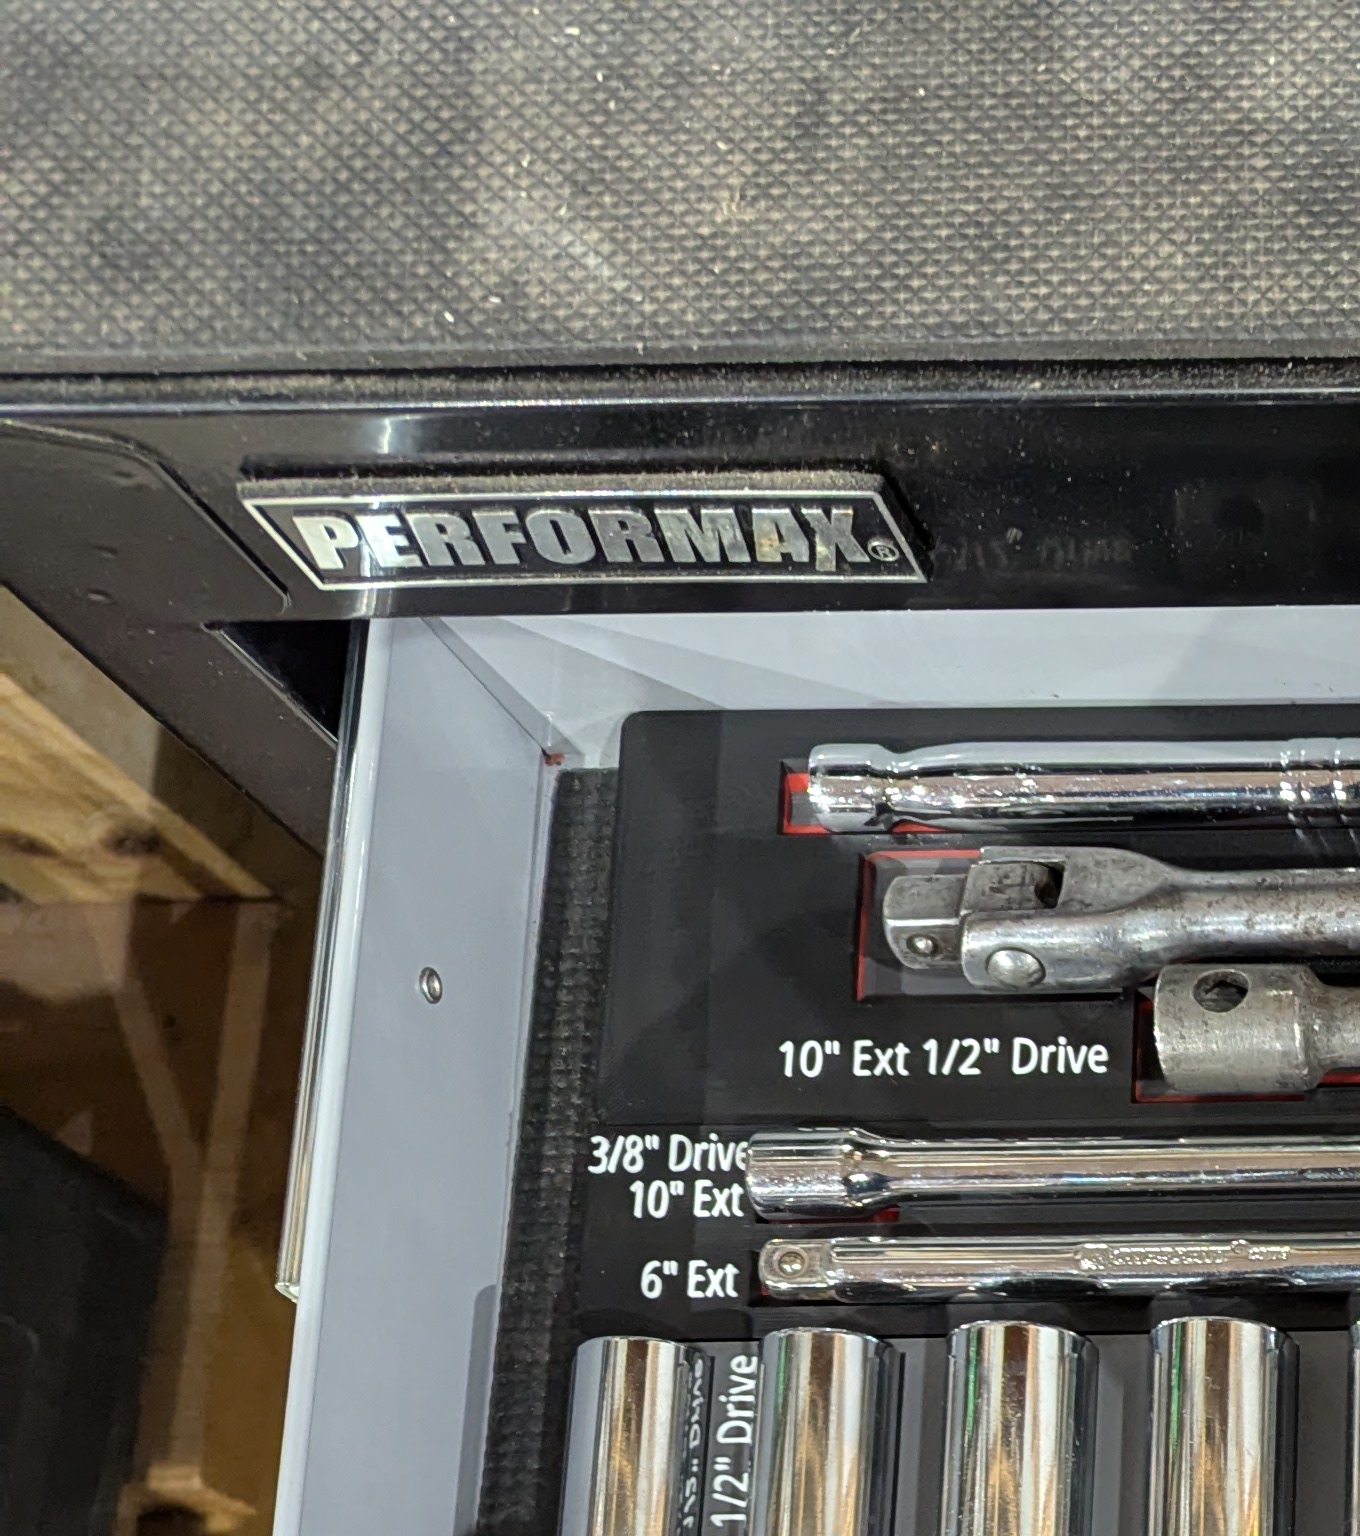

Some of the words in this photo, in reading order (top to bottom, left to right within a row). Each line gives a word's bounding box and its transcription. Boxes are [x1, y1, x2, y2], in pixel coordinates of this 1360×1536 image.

[779, 1040, 840, 1077] 10"
[853, 1040, 910, 1076] Ext
[923, 1038, 999, 1075] 1/2"
[1012, 1036, 1108, 1074] Drive
[588, 1135, 659, 1174] 3/8"
[669, 1134, 749, 1172] Drive
[627, 1182, 684, 1218] 10"
[694, 1182, 745, 1217] Ext
[641, 1260, 678, 1298] 6"
[687, 1260, 739, 1298] Ext
[717, 1355, 758, 1445] Drive
[712, 1456, 748, 1527] 1/2"
